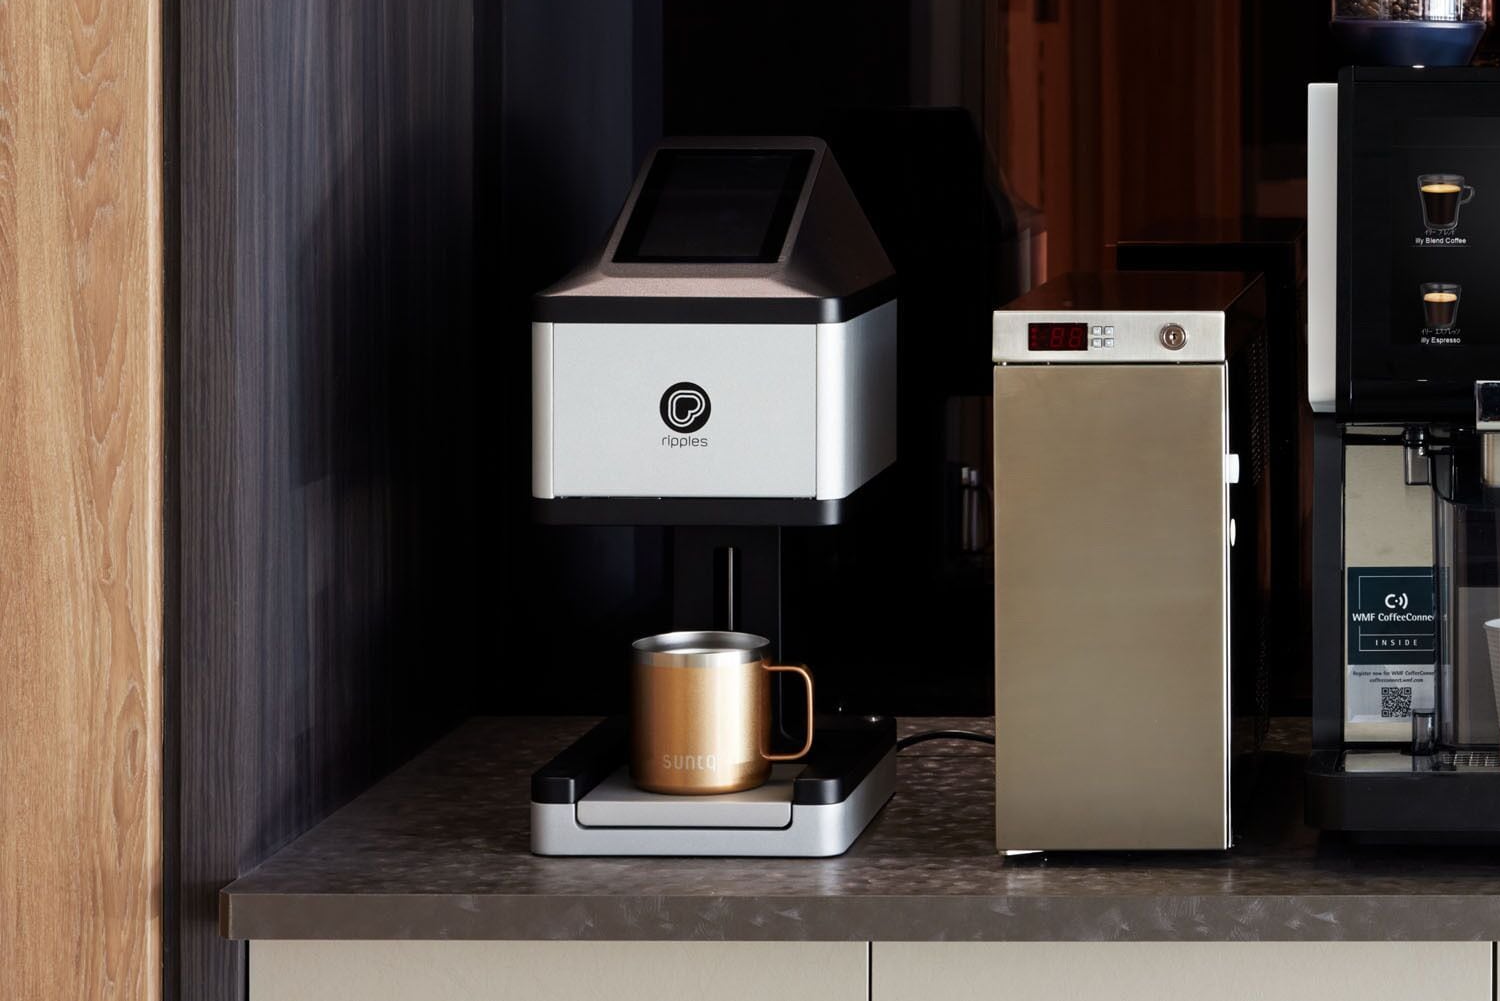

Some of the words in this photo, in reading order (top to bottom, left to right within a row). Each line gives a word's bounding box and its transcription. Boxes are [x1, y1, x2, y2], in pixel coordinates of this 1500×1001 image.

[1431, 336, 1461, 345] Espresso
[661, 435, 708, 449] ripples
[1352, 612, 1376, 622] WMF
[1378, 612, 1435, 622] CoffeeConne
[1375, 639, 1418, 647] INSIDE
